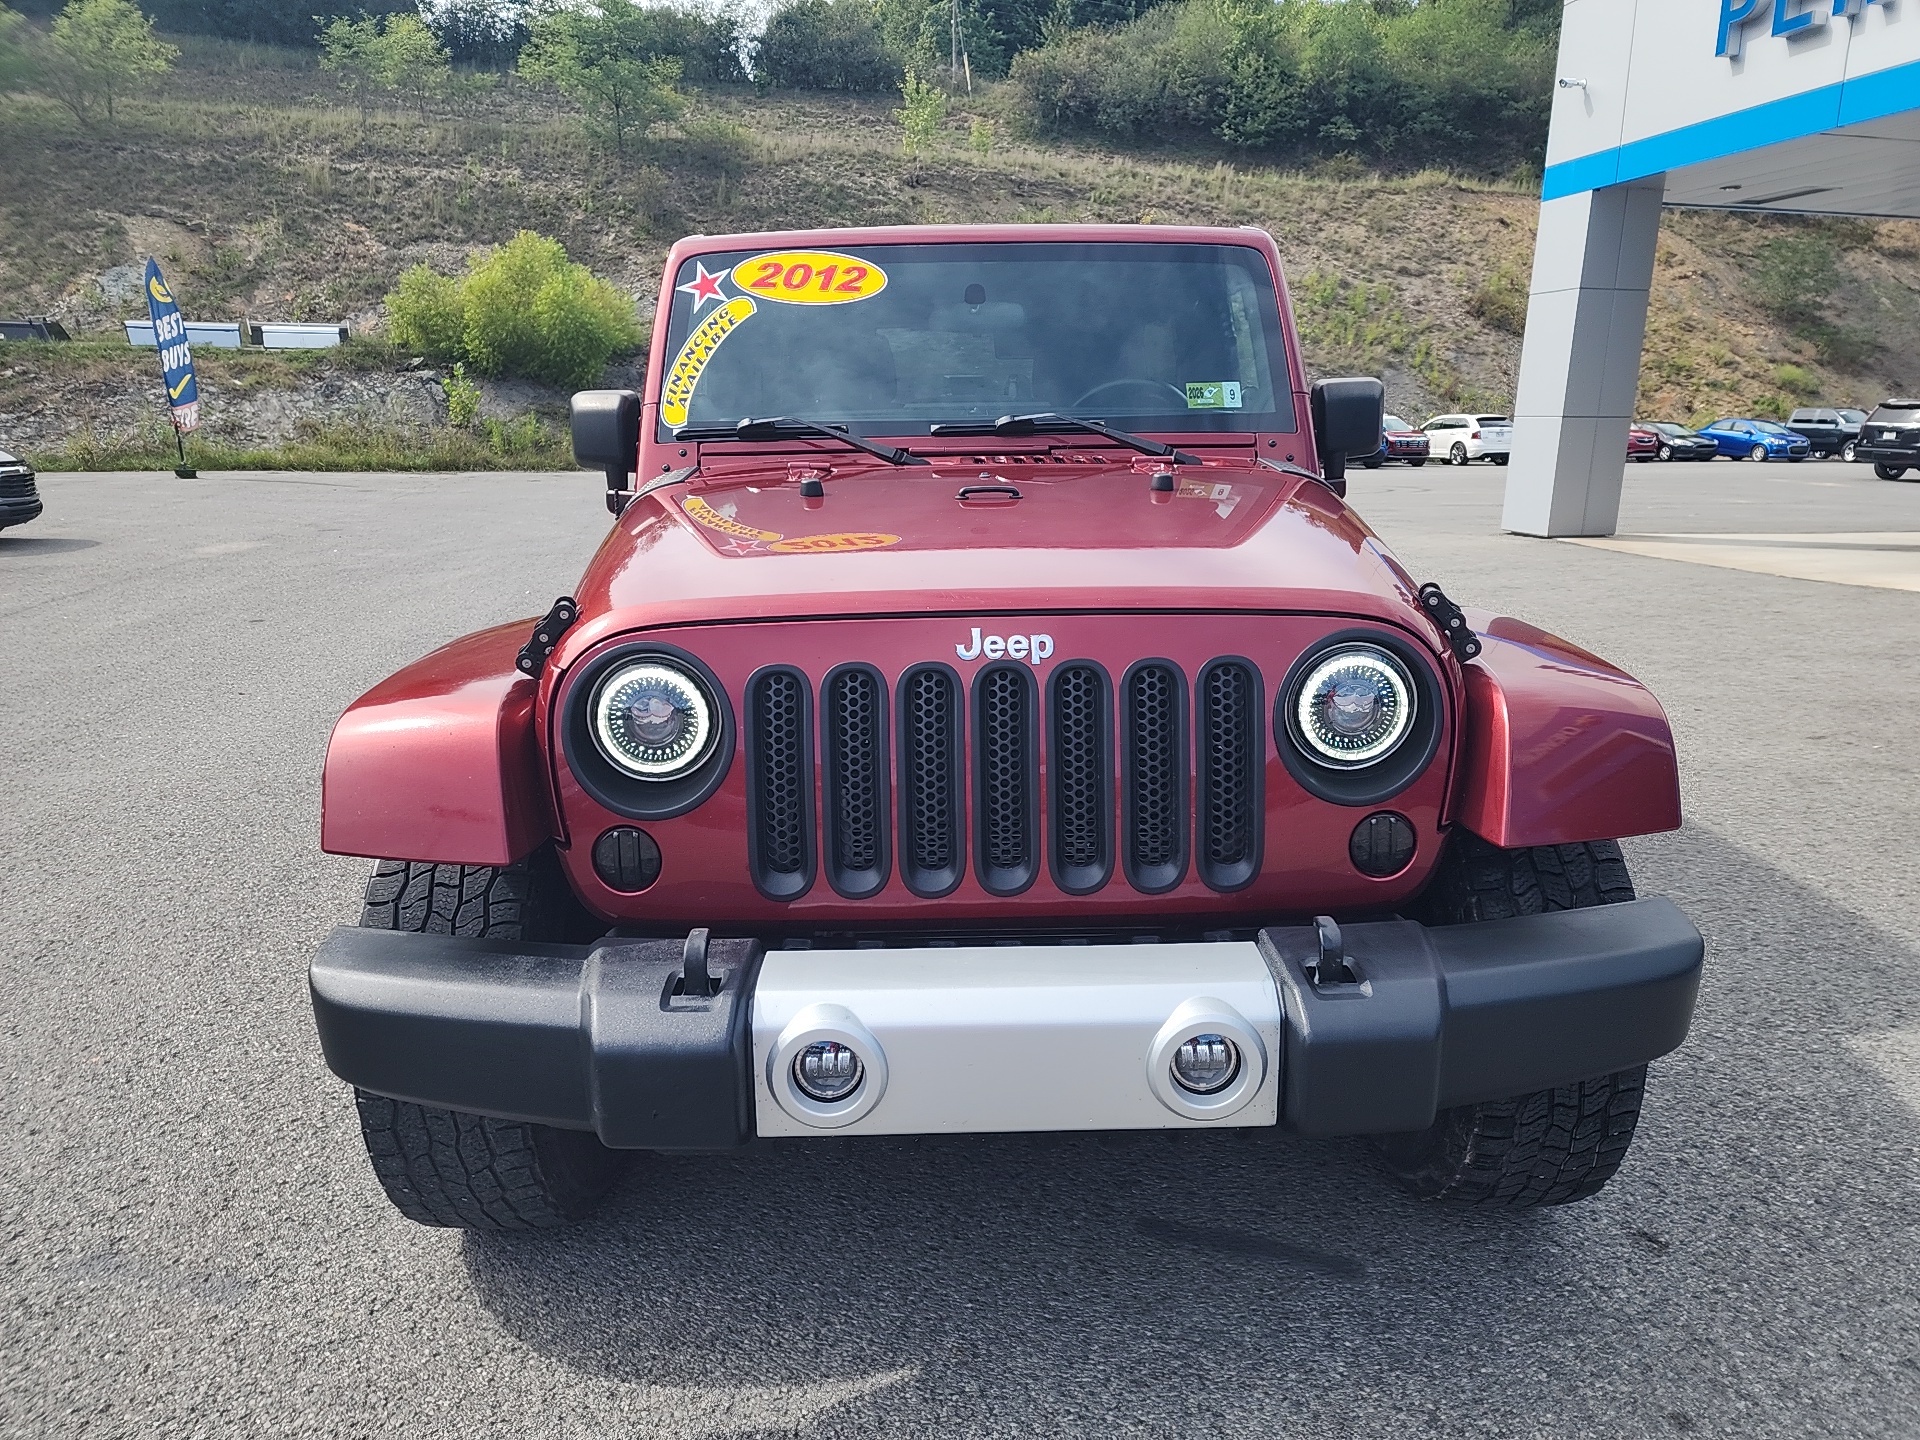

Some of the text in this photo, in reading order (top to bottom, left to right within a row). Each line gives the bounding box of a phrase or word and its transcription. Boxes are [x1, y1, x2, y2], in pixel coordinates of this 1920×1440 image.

[749, 262, 869, 294] 2012
[156, 312, 185, 342] BEST
[162, 341, 191, 373] BUYS
[665, 307, 730, 407] FINANCING
[677, 314, 738, 409] AVAILABLE
[1188, 387, 1204, 399] 2026
[1229, 389, 1236, 401] 9
[955, 627, 1054, 665] Jeep
